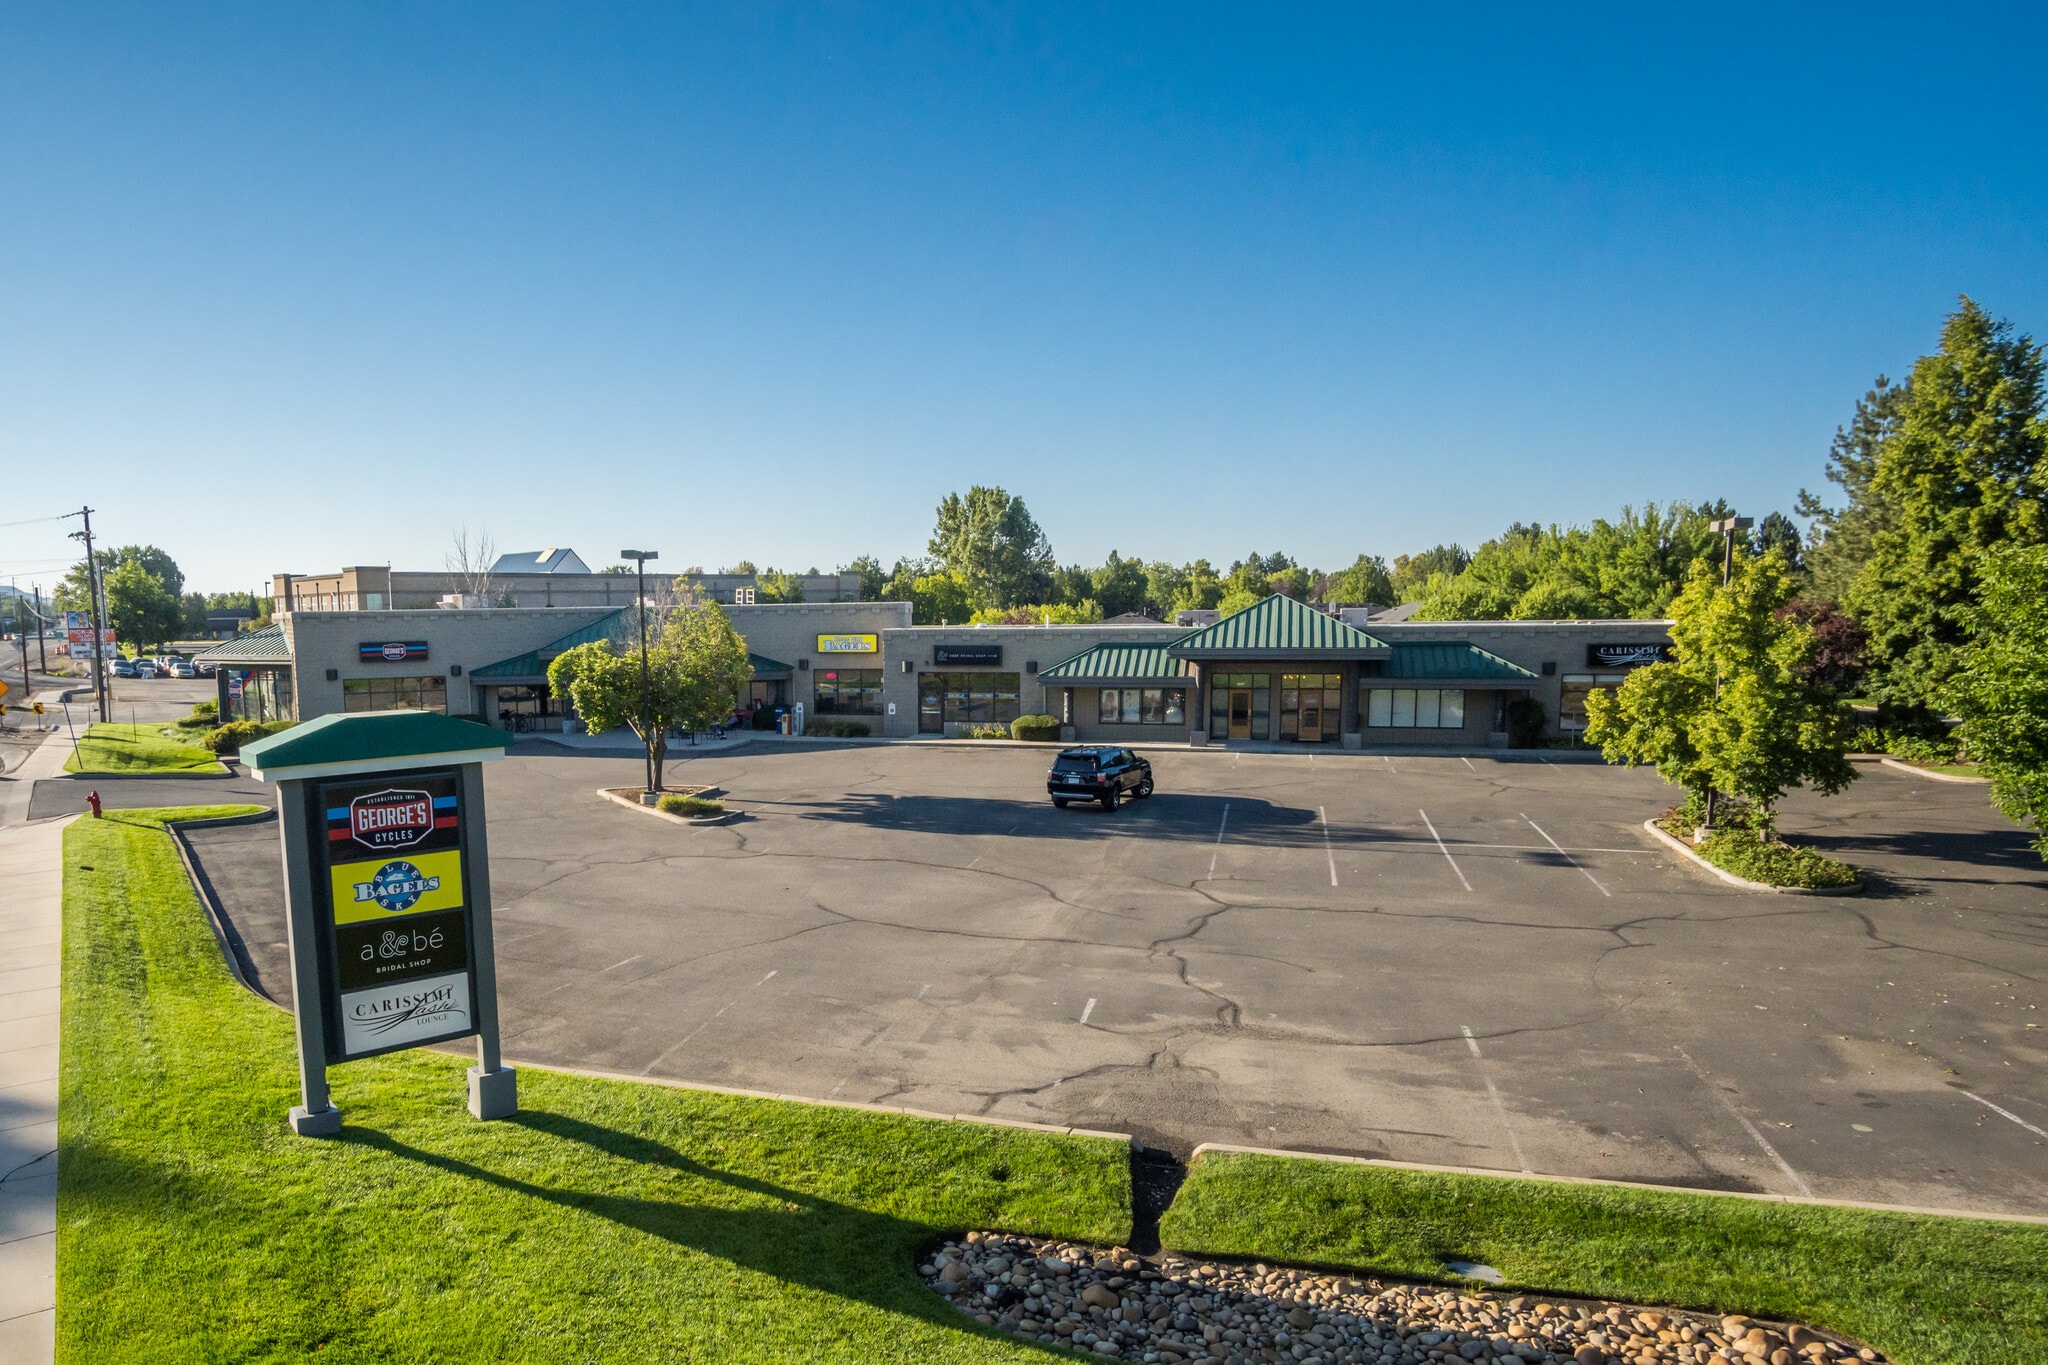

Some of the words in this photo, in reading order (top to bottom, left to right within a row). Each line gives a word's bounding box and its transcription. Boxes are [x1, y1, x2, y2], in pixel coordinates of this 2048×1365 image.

[823, 640, 871, 651] BAGELS
[358, 802, 426, 831] GEORGE'S
[375, 830, 413, 843] CYCLES
[375, 863, 420, 883] BLUE
[353, 877, 439, 902] BAGELS
[380, 895, 416, 910] SKY
[376, 963, 407, 974] BRIDAL
[409, 958, 432, 968] SHOP
[355, 988, 451, 1017] CARISSIMI
[416, 1013, 449, 1026] LOUNGE
